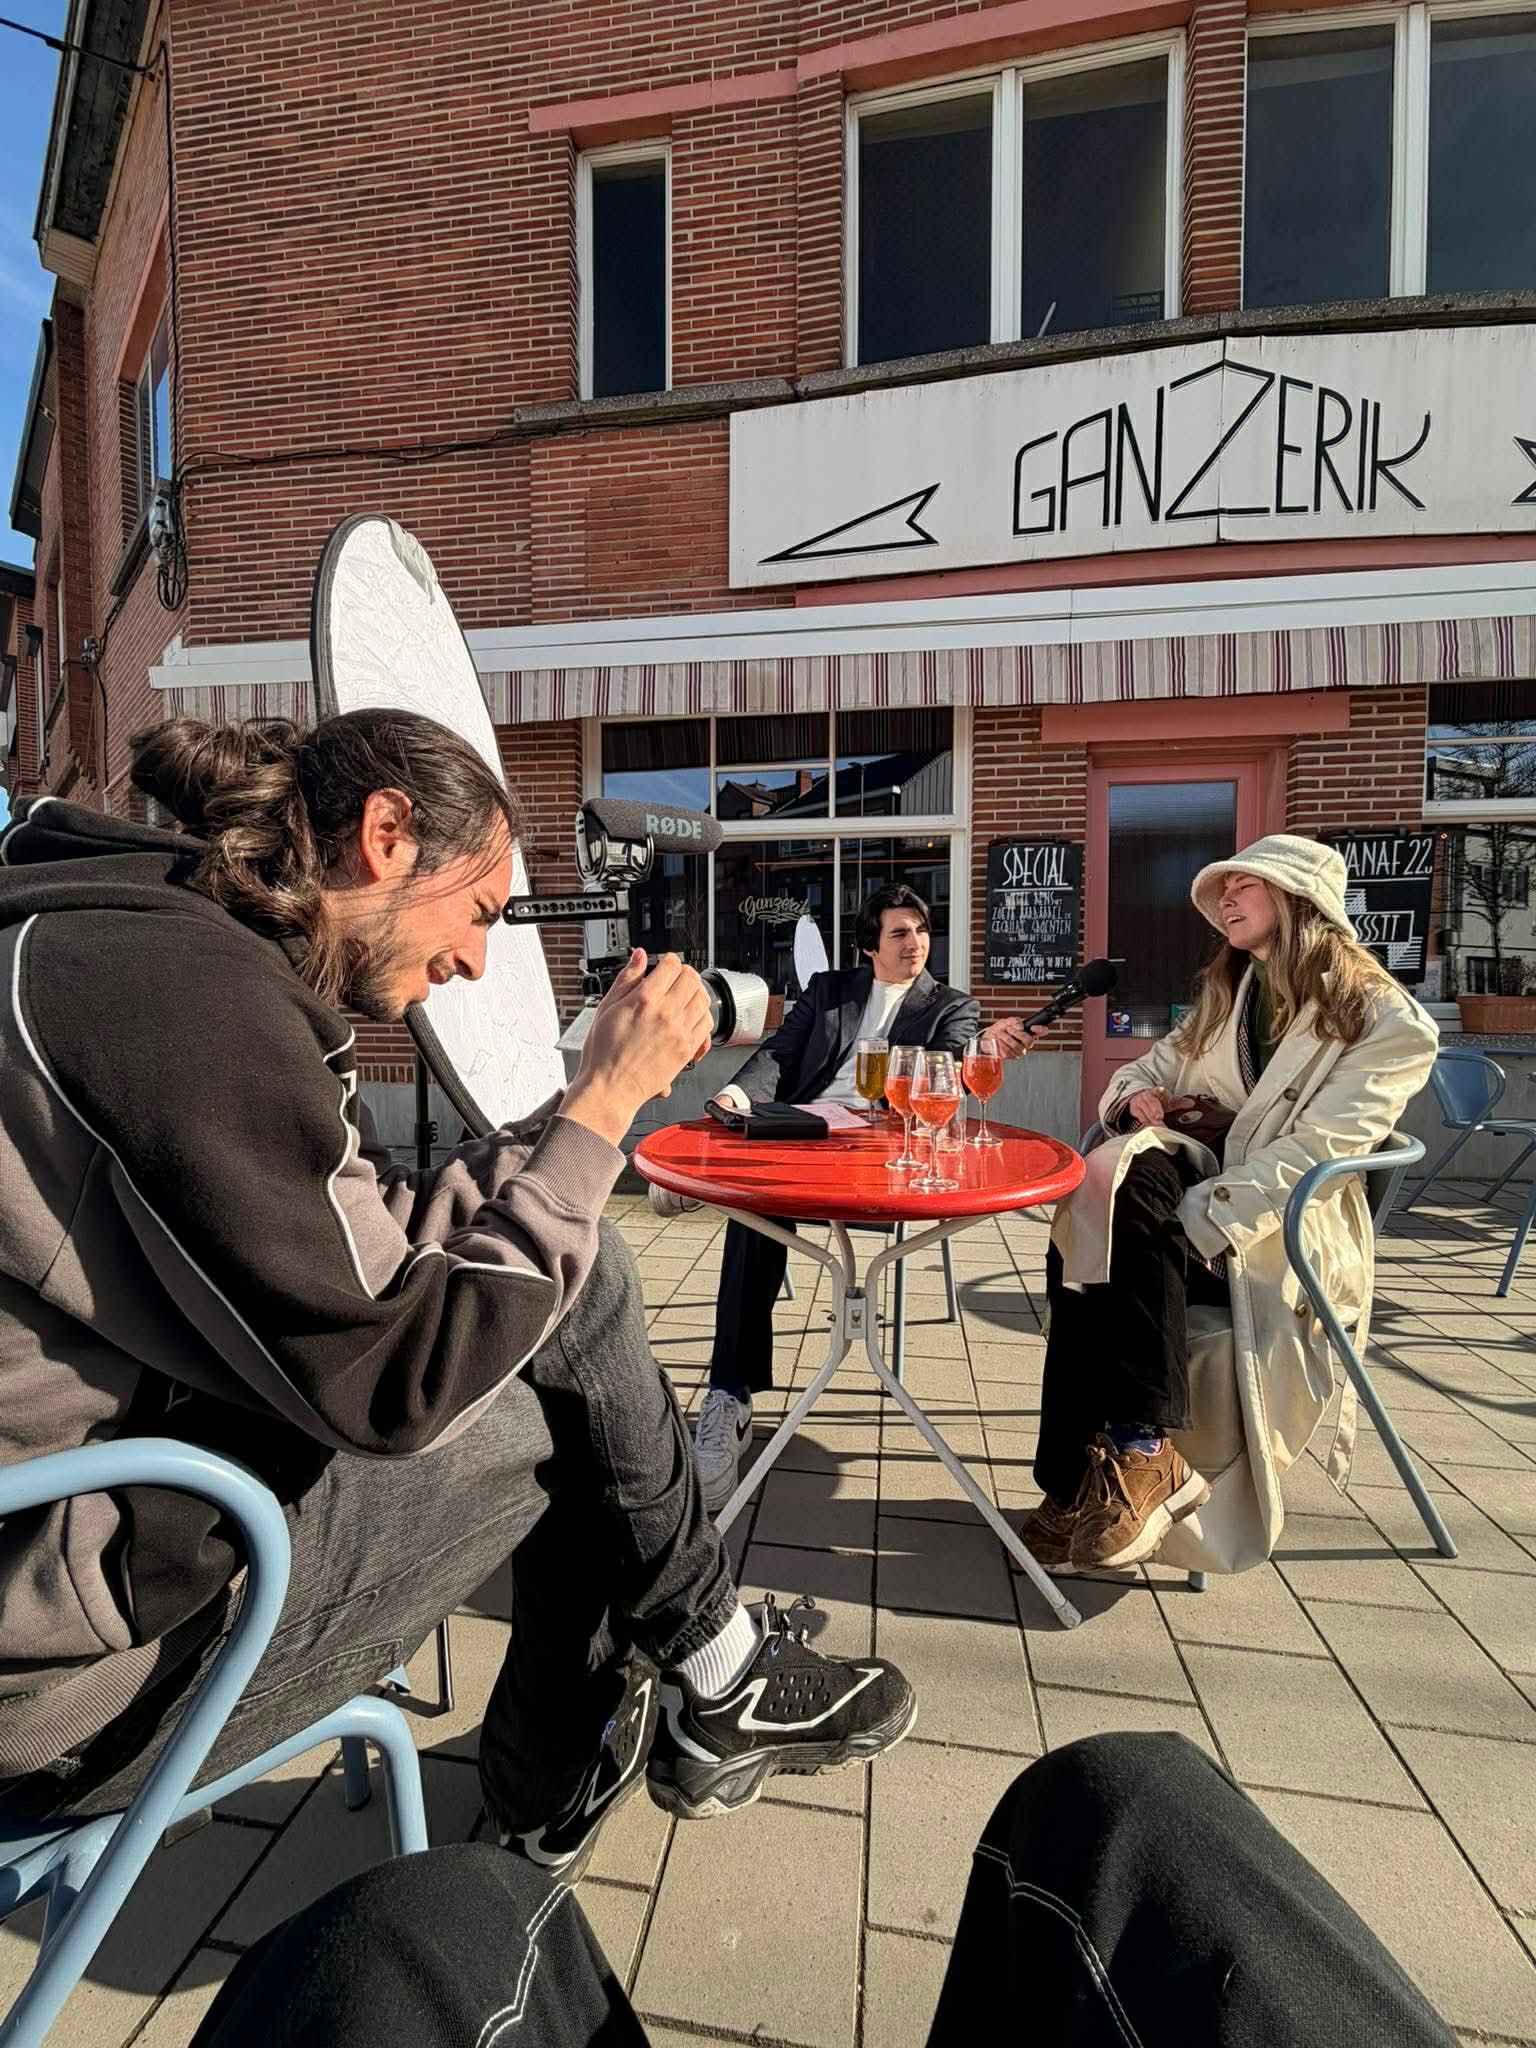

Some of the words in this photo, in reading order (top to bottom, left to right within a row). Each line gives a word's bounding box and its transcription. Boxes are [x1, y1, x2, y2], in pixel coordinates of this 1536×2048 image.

[1012, 358, 1432, 536] GANZERIK
[646, 814, 702, 840] RØDE
[1002, 846, 1069, 887] SPECIAL
[1335, 840, 1405, 877] VANAF
[1010, 967, 1045, 982] BRUNCH
